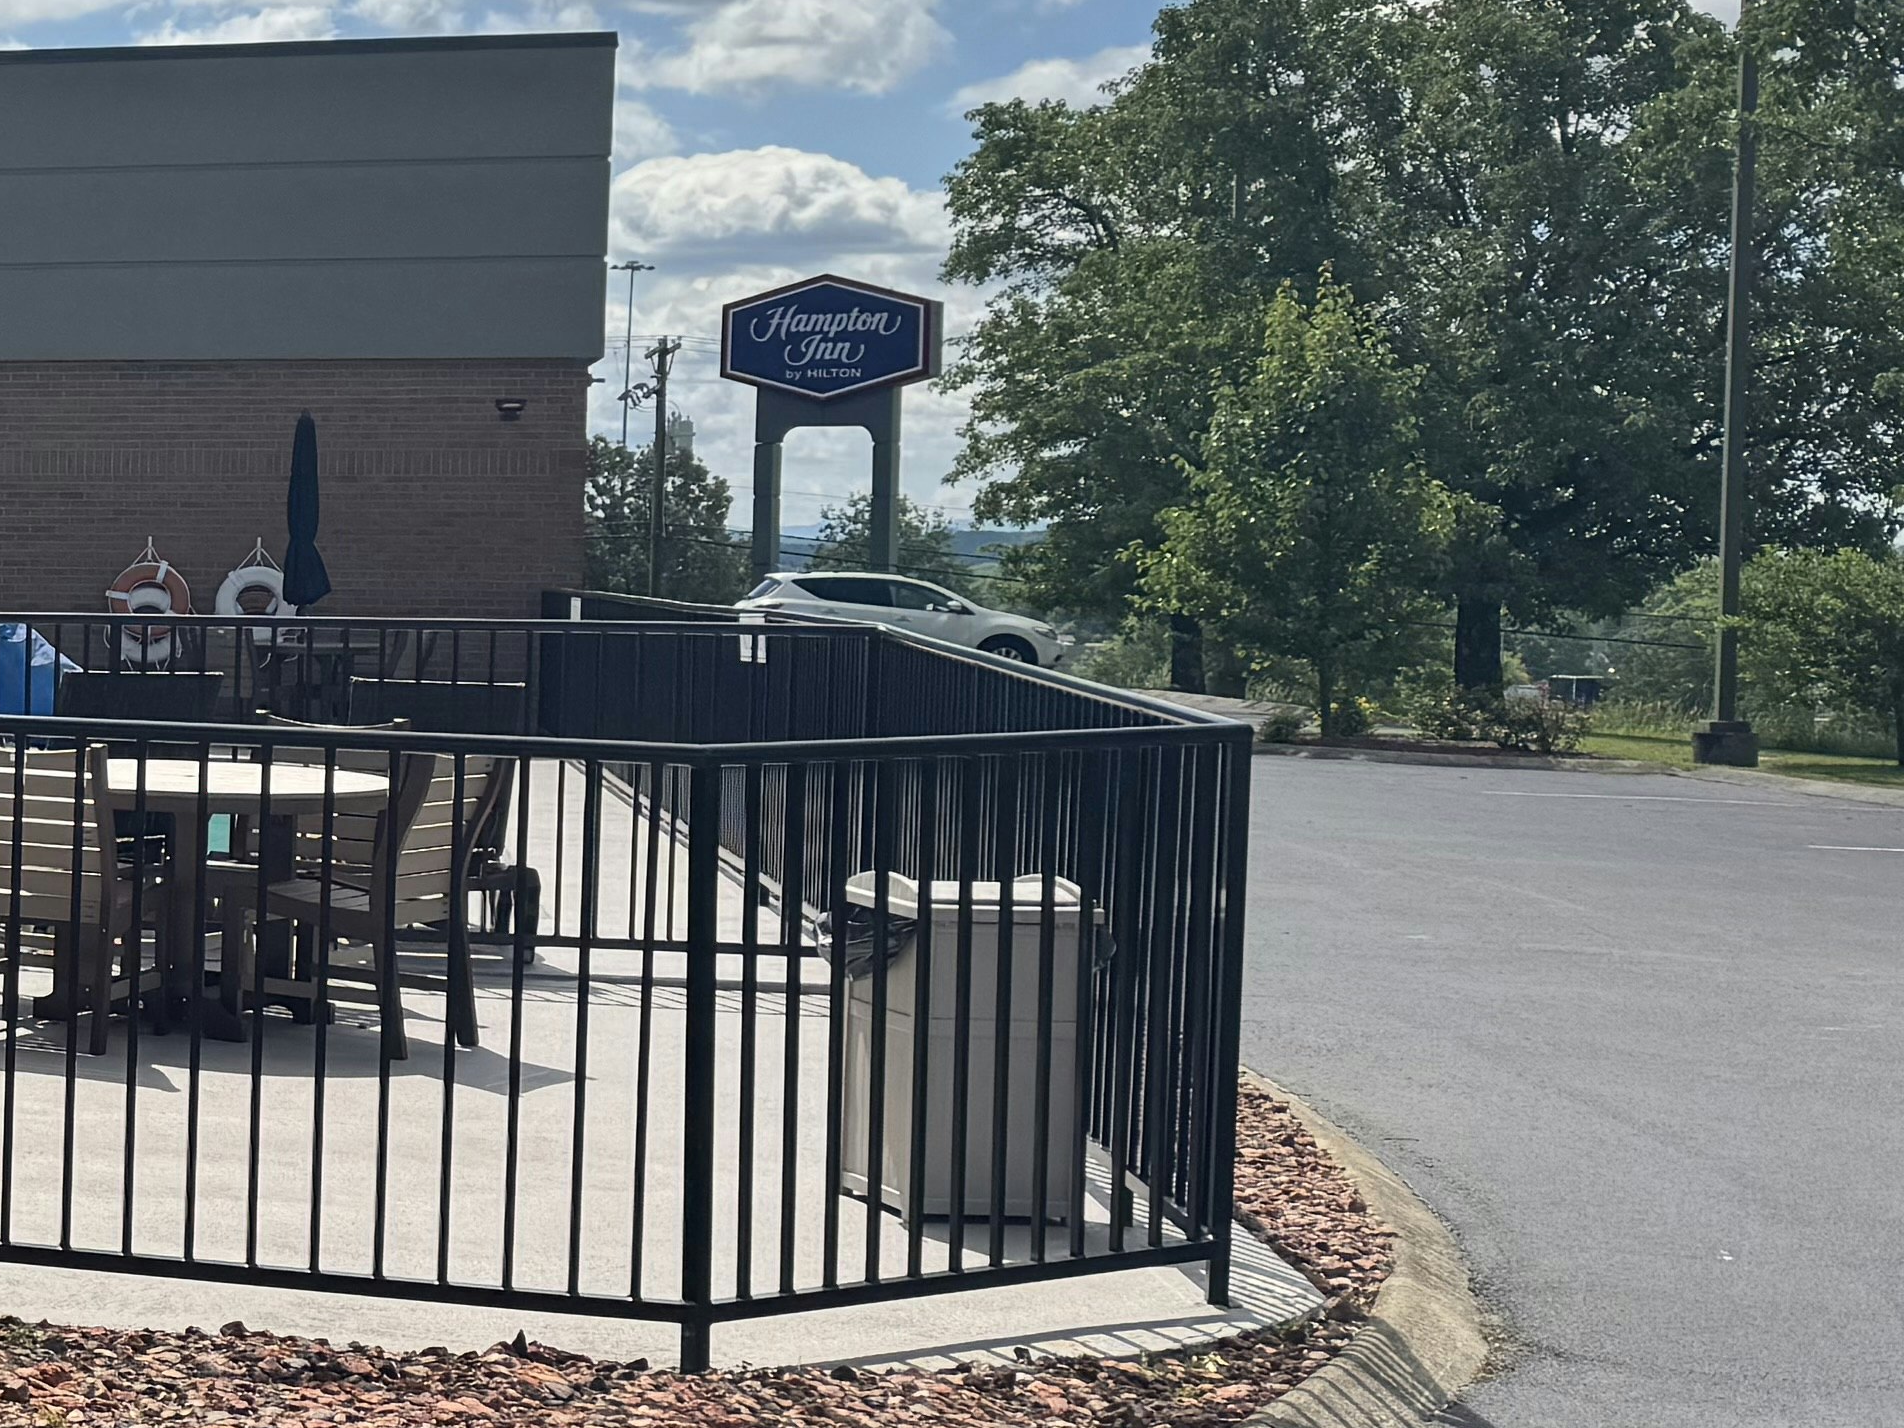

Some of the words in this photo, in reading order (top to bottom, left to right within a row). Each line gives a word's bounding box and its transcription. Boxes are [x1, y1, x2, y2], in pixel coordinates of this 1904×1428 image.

[750, 304, 902, 342] Hampton
[784, 334, 865, 366] Inn
[785, 369, 802, 380] by
[807, 368, 862, 378] HILTON
